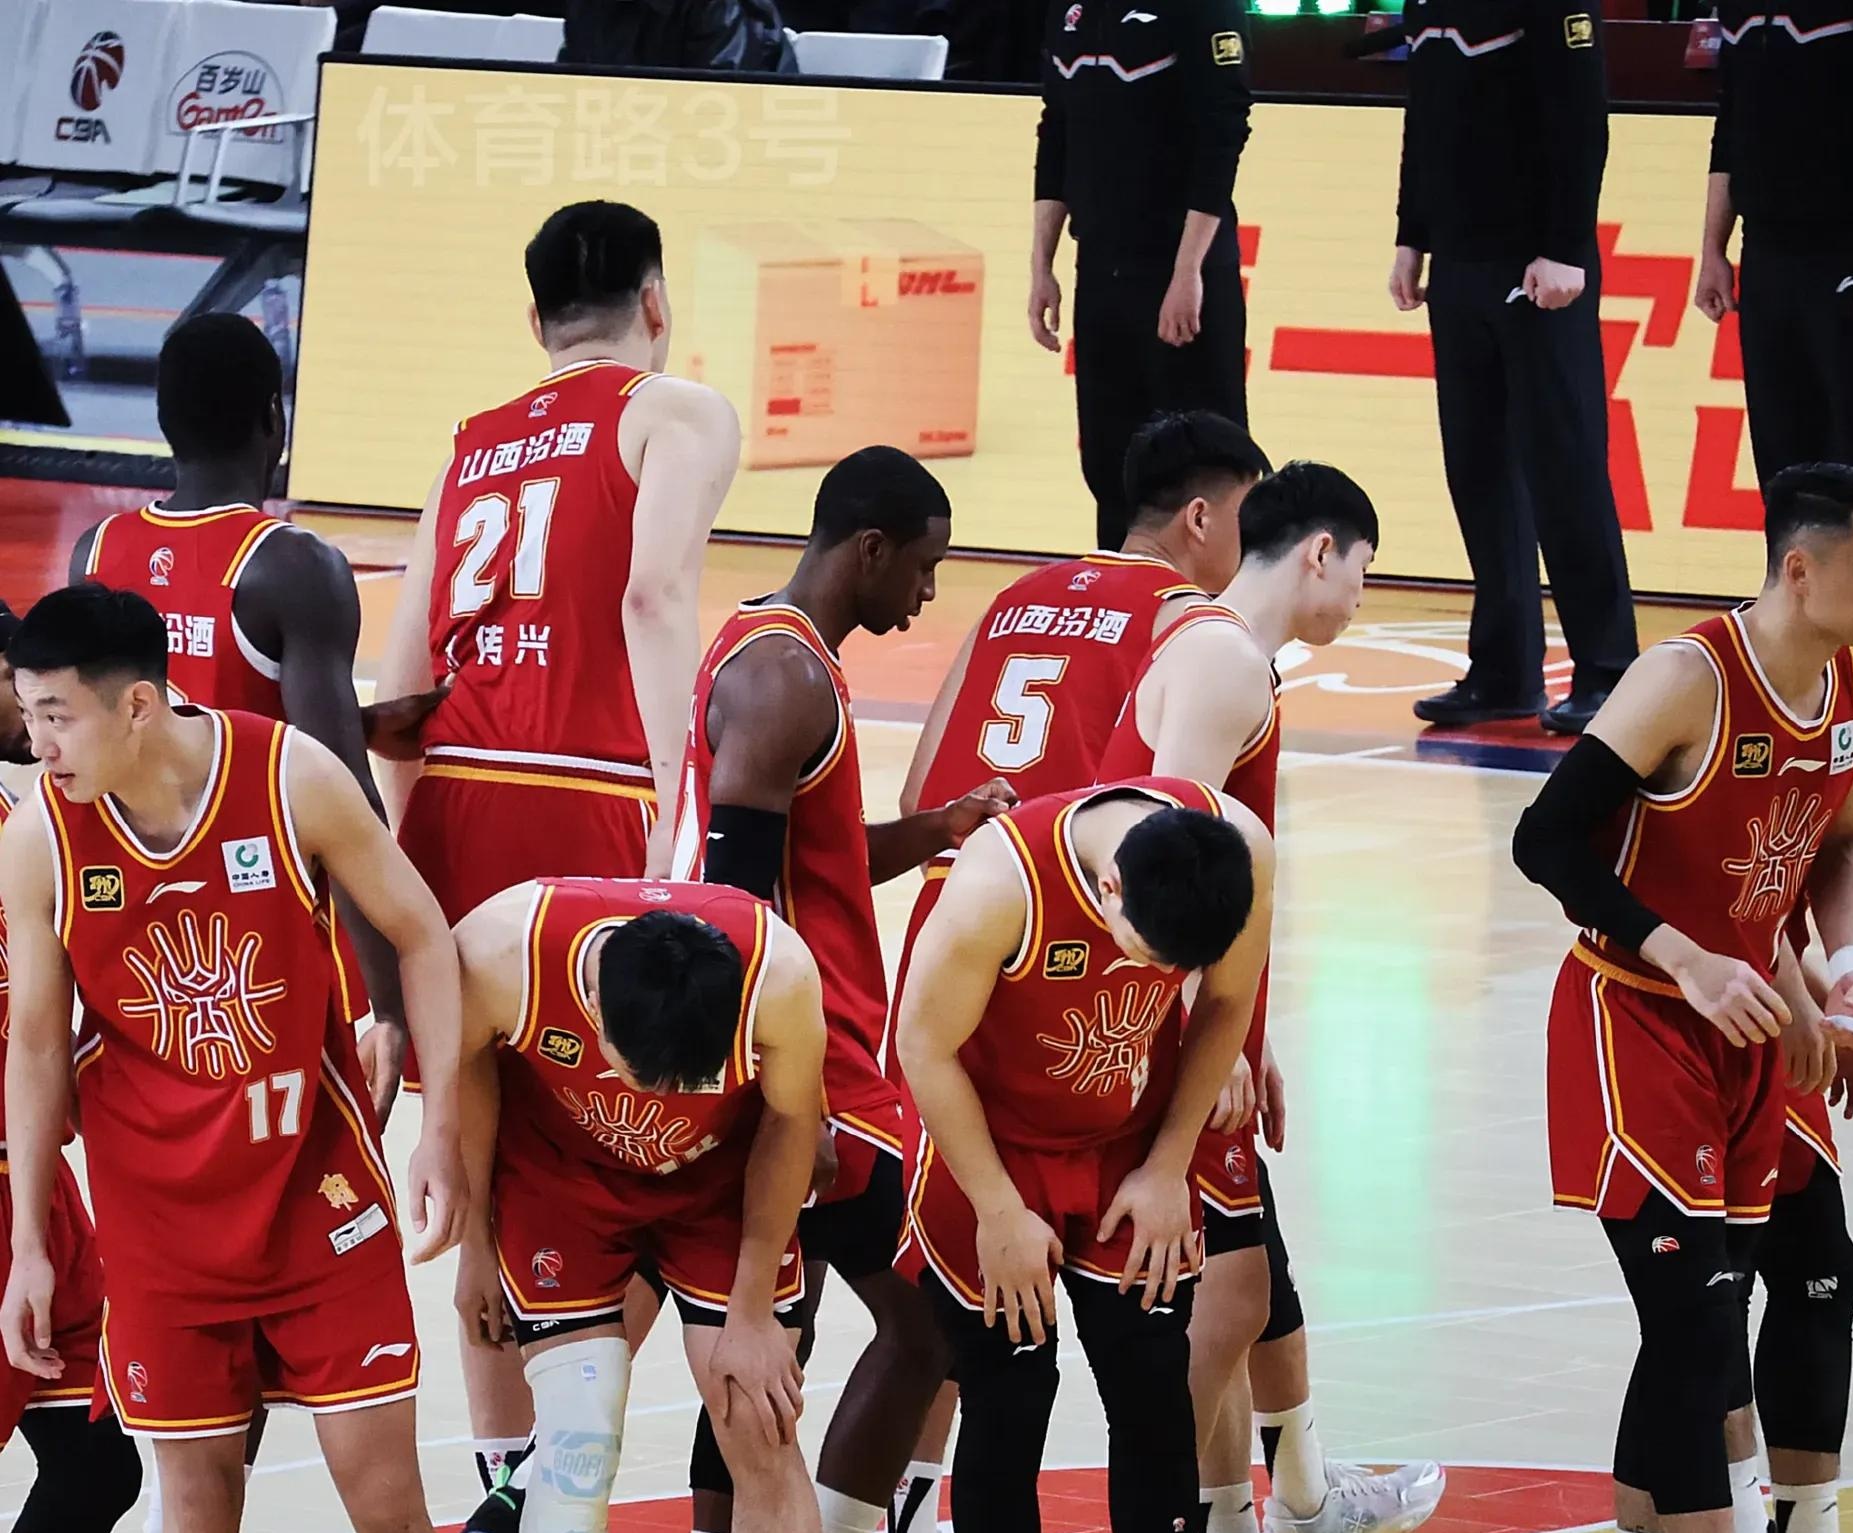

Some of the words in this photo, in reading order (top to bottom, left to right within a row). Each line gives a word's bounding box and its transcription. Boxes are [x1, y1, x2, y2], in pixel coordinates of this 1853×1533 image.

[196, 65, 266, 95] 百岁山
[55, 116, 112, 145] CBA
[457, 422, 594, 487] 山西汾酒
[450, 477, 560, 618] 21
[988, 604, 1133, 645] 山西汾酒
[977, 653, 1071, 773] 5
[245, 1068, 305, 1144] 17
